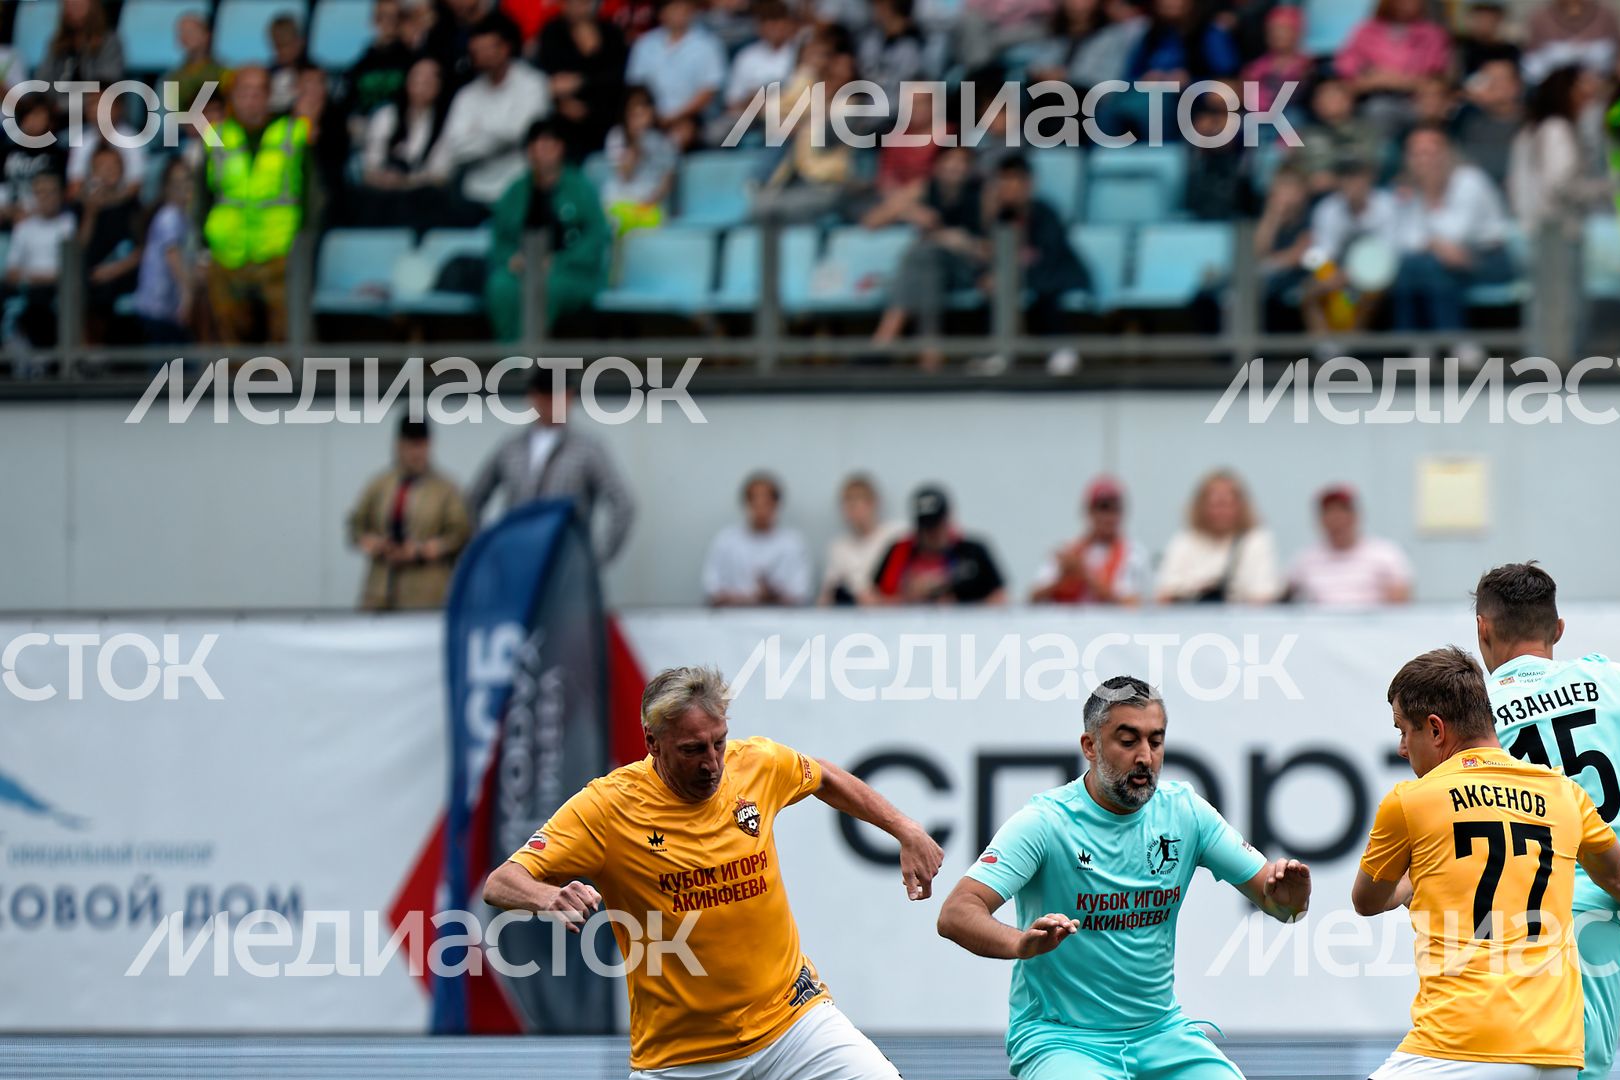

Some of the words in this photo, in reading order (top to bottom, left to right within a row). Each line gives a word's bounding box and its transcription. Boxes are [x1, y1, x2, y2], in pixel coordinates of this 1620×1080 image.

[1508, 708, 1620, 824] 15
[1449, 785, 1546, 817] АКСЕНОВ
[659, 866, 718, 894] КУБОК
[720, 850, 768, 882] ИГОРЯ
[1453, 821, 1555, 942] 77
[0, 872, 162, 932] ОВОЙ
[671, 876, 768, 913] АКИНФЕЕВА
[1076, 891, 1128, 914] КУБОК
[1134, 886, 1181, 908] ИГОРЯ
[1081, 908, 1170, 931] АКИНФЕЕВА
